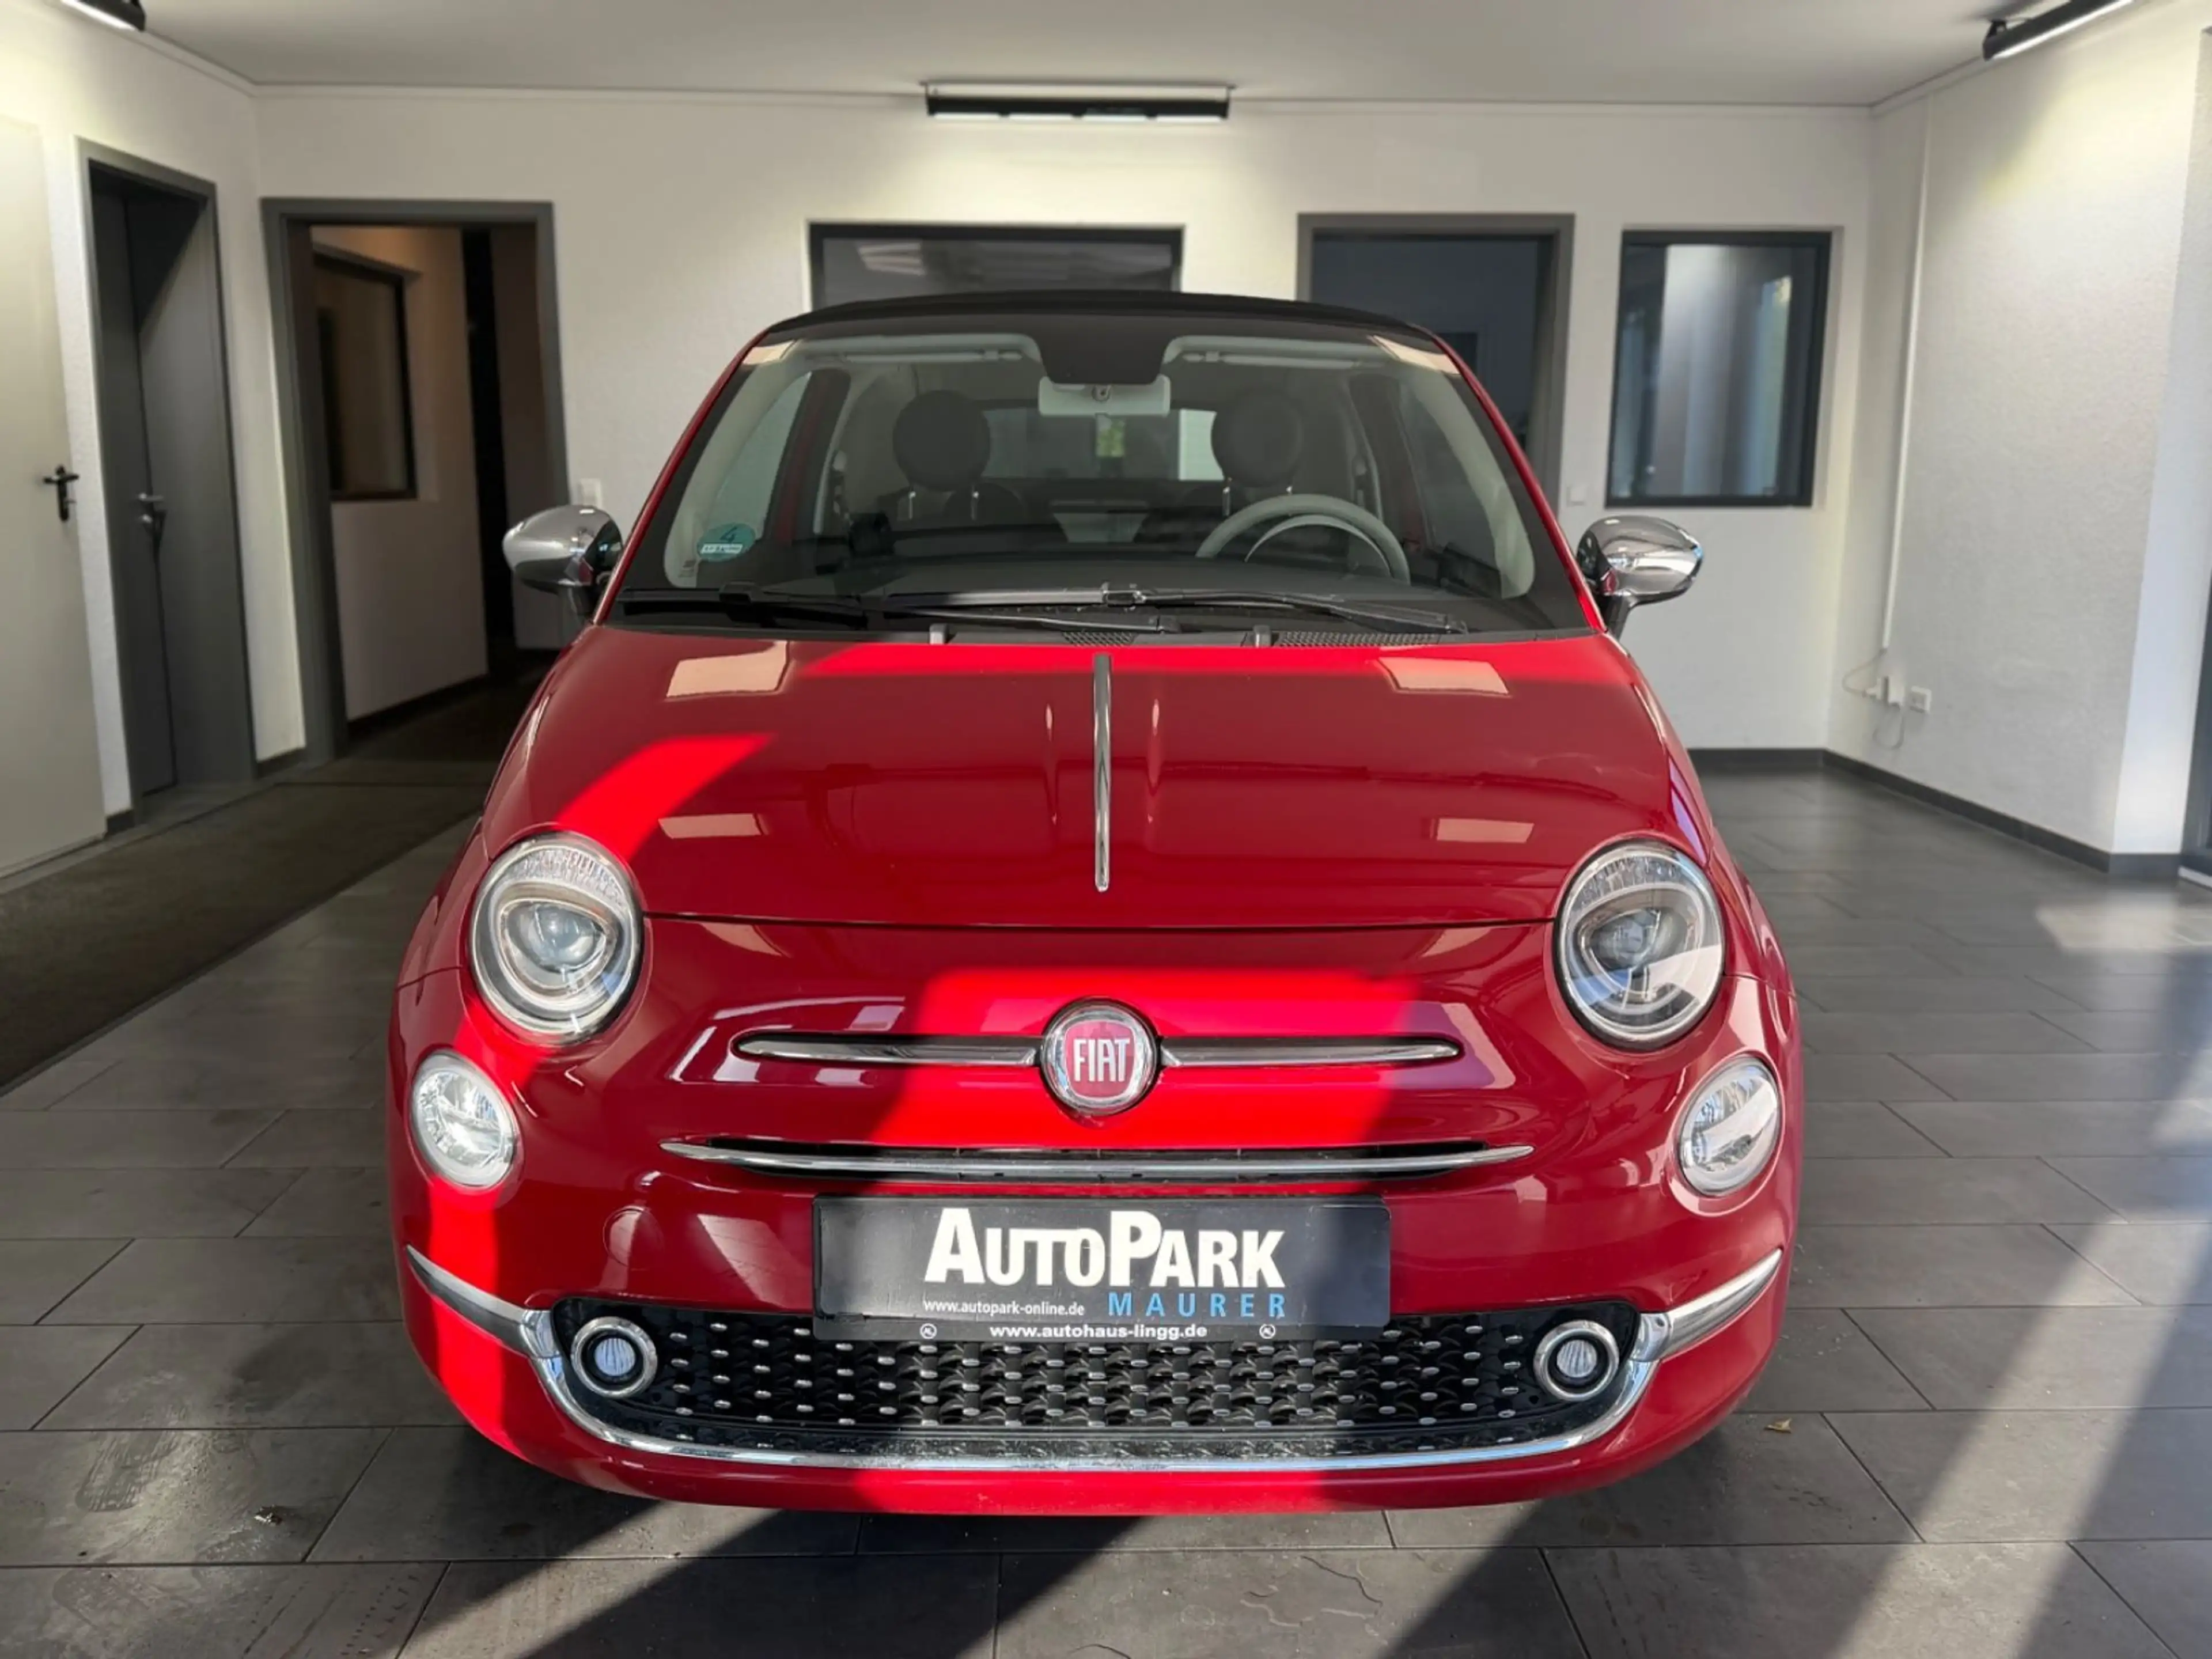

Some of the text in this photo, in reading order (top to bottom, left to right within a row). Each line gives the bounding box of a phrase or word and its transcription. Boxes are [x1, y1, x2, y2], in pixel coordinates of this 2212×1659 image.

[719, 526, 738, 543] 4
[1073, 1038, 1130, 1082] FIAT
[923, 1300, 1085, 1316] www.autopark-online.de
[1108, 1291, 1286, 1318] MAURER
[989, 1324, 1208, 1340] www.autohaus-lingg.de
